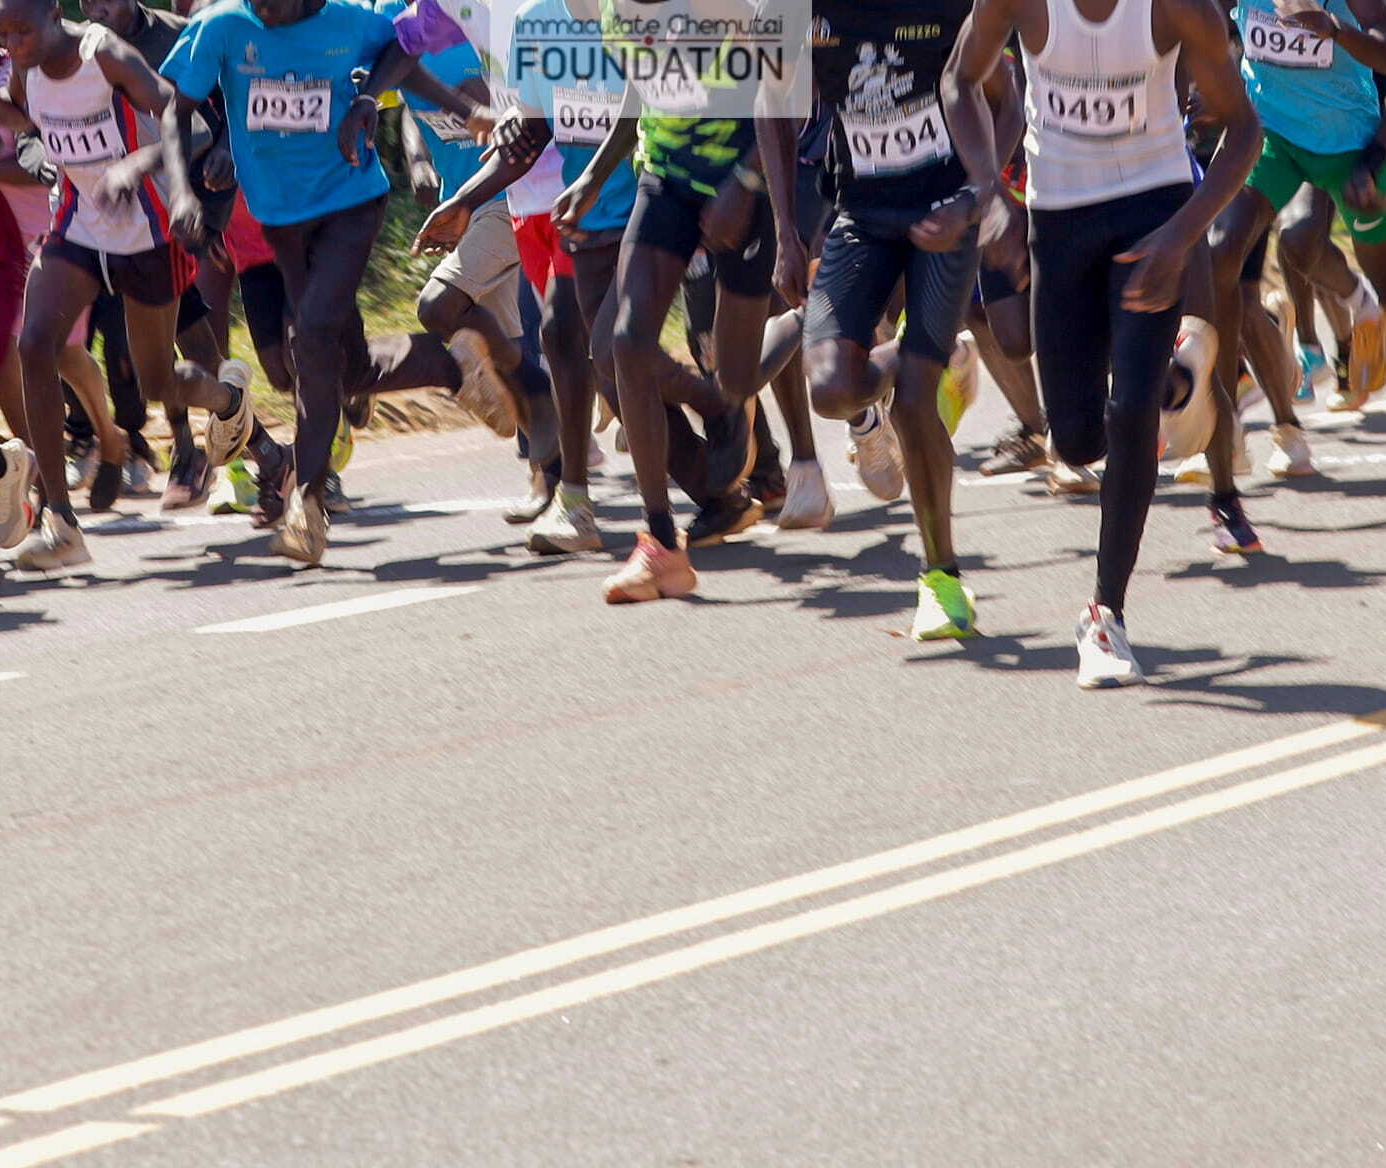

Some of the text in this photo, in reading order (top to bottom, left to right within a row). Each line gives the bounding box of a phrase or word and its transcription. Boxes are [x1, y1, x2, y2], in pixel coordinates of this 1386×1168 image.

[1250, 26, 1327, 56] 0947
[251, 94, 324, 122] 0932
[1046, 91, 1135, 125] 0491
[47, 128, 108, 155] 0111
[851, 116, 938, 158] 0794
